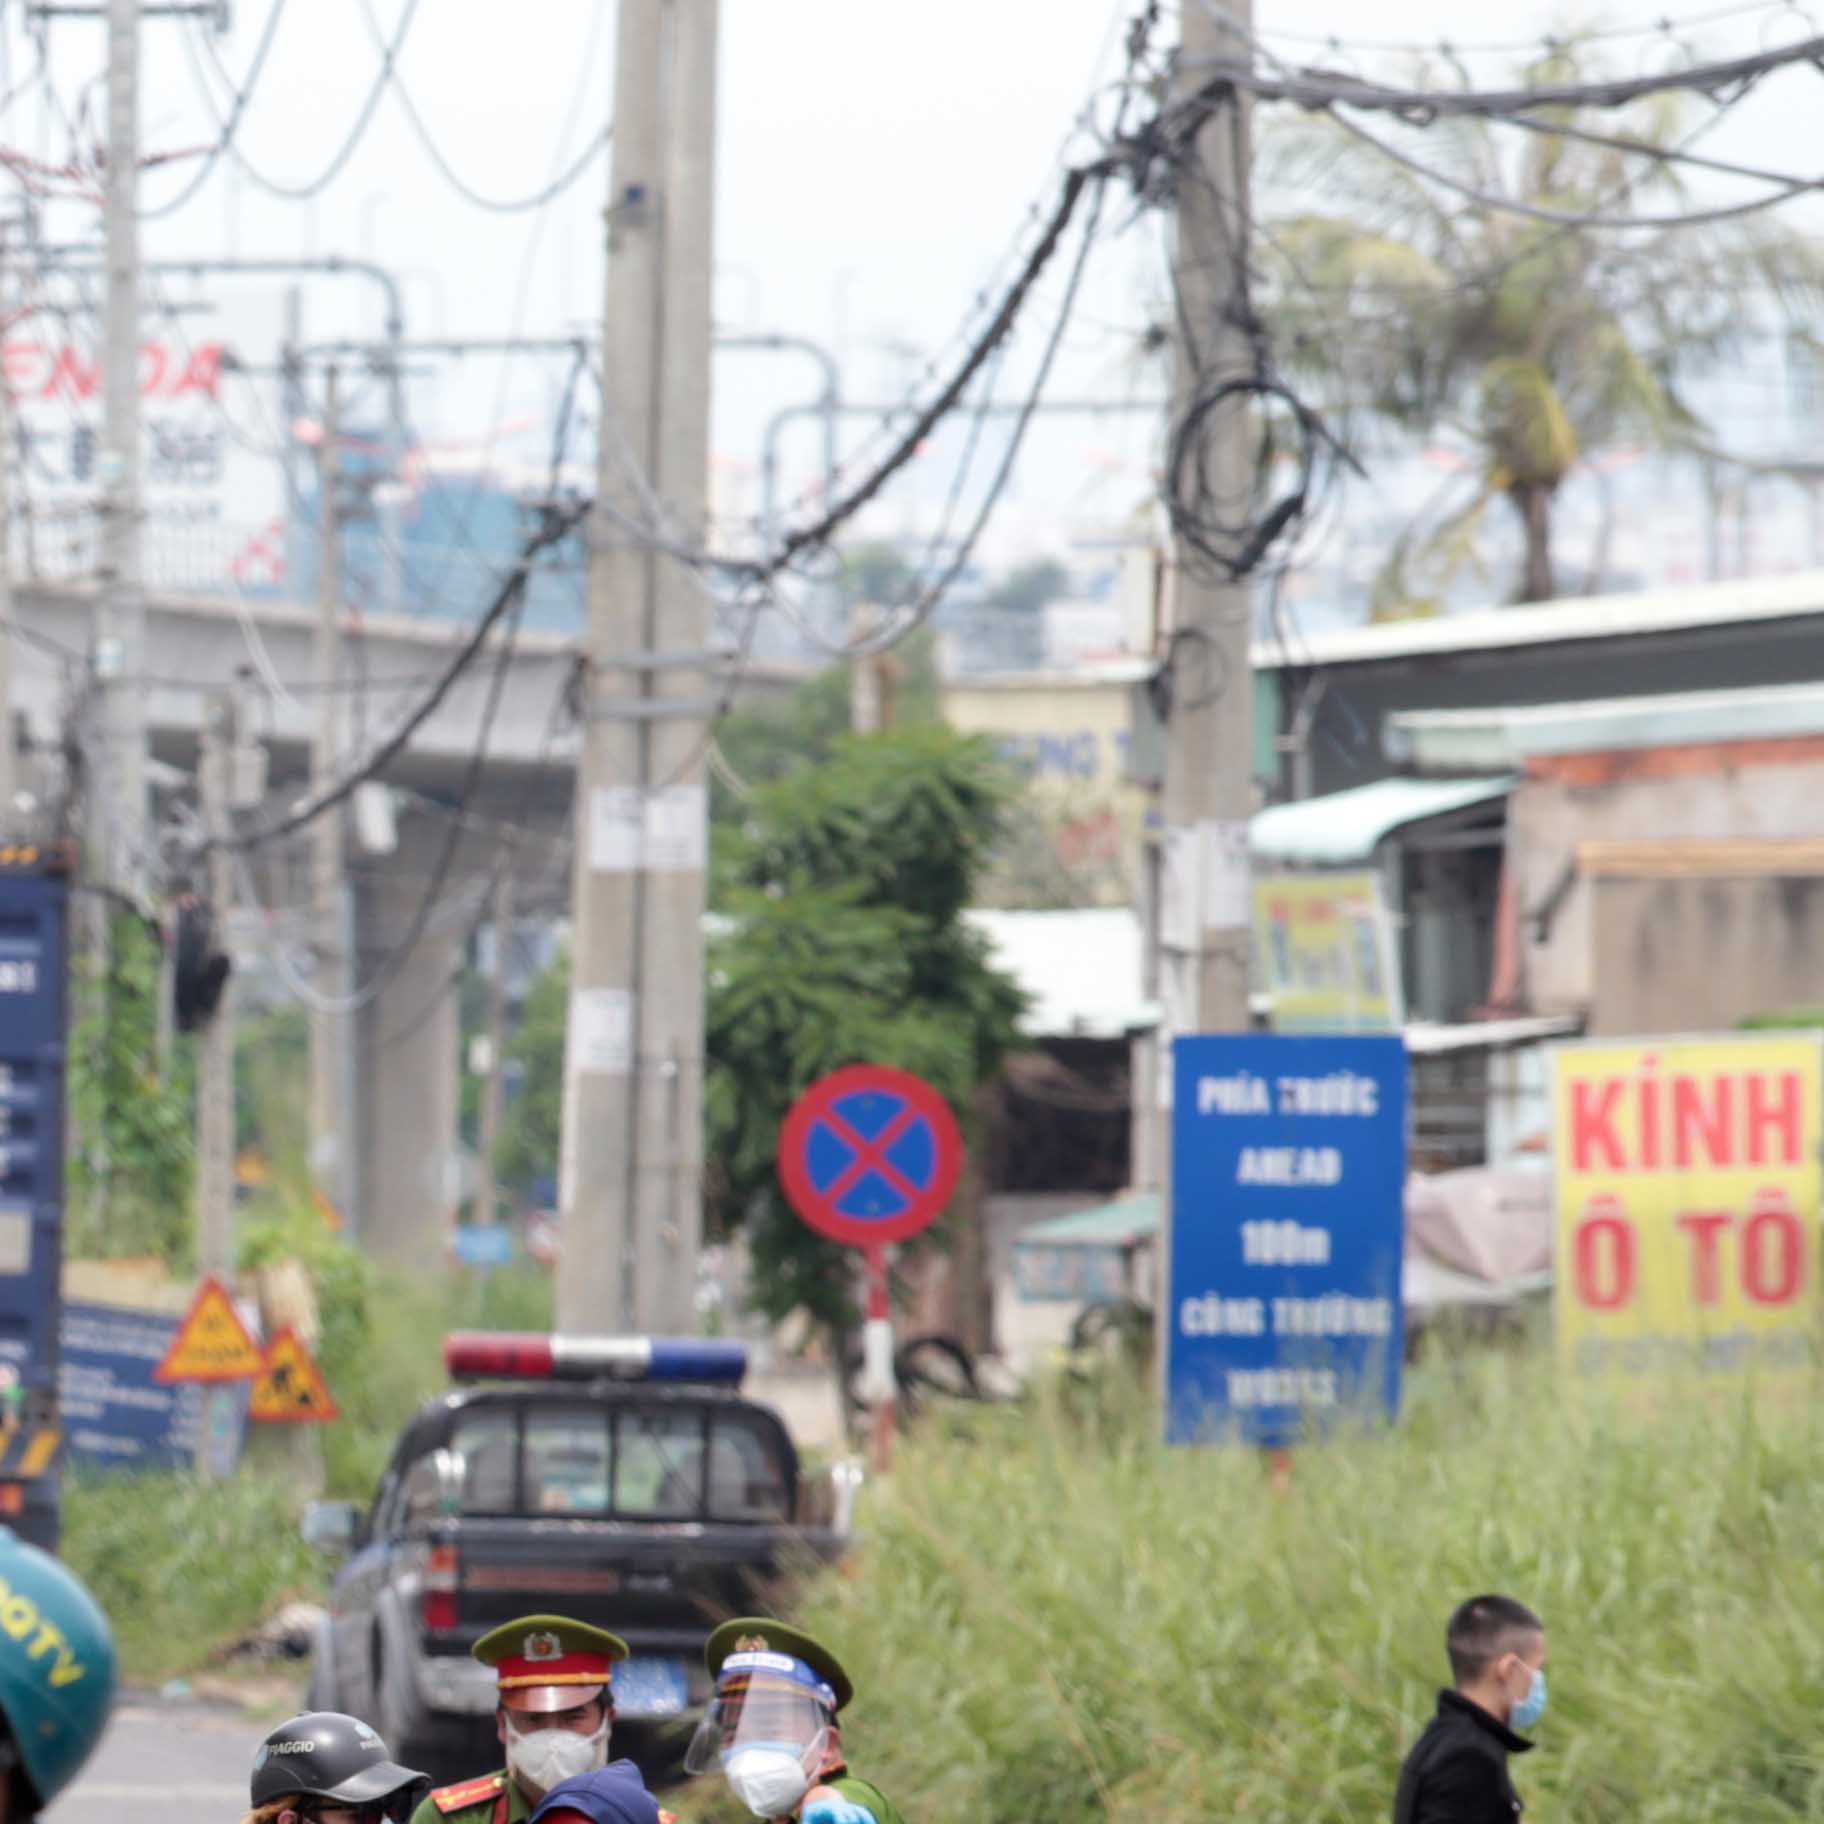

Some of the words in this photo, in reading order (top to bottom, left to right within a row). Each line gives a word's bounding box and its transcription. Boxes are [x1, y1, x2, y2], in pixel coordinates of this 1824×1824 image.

[1570, 1050, 1803, 1174] KÍNH
[1574, 1190, 1639, 1315] Ô
[1674, 1185, 1807, 1310] TÔ
